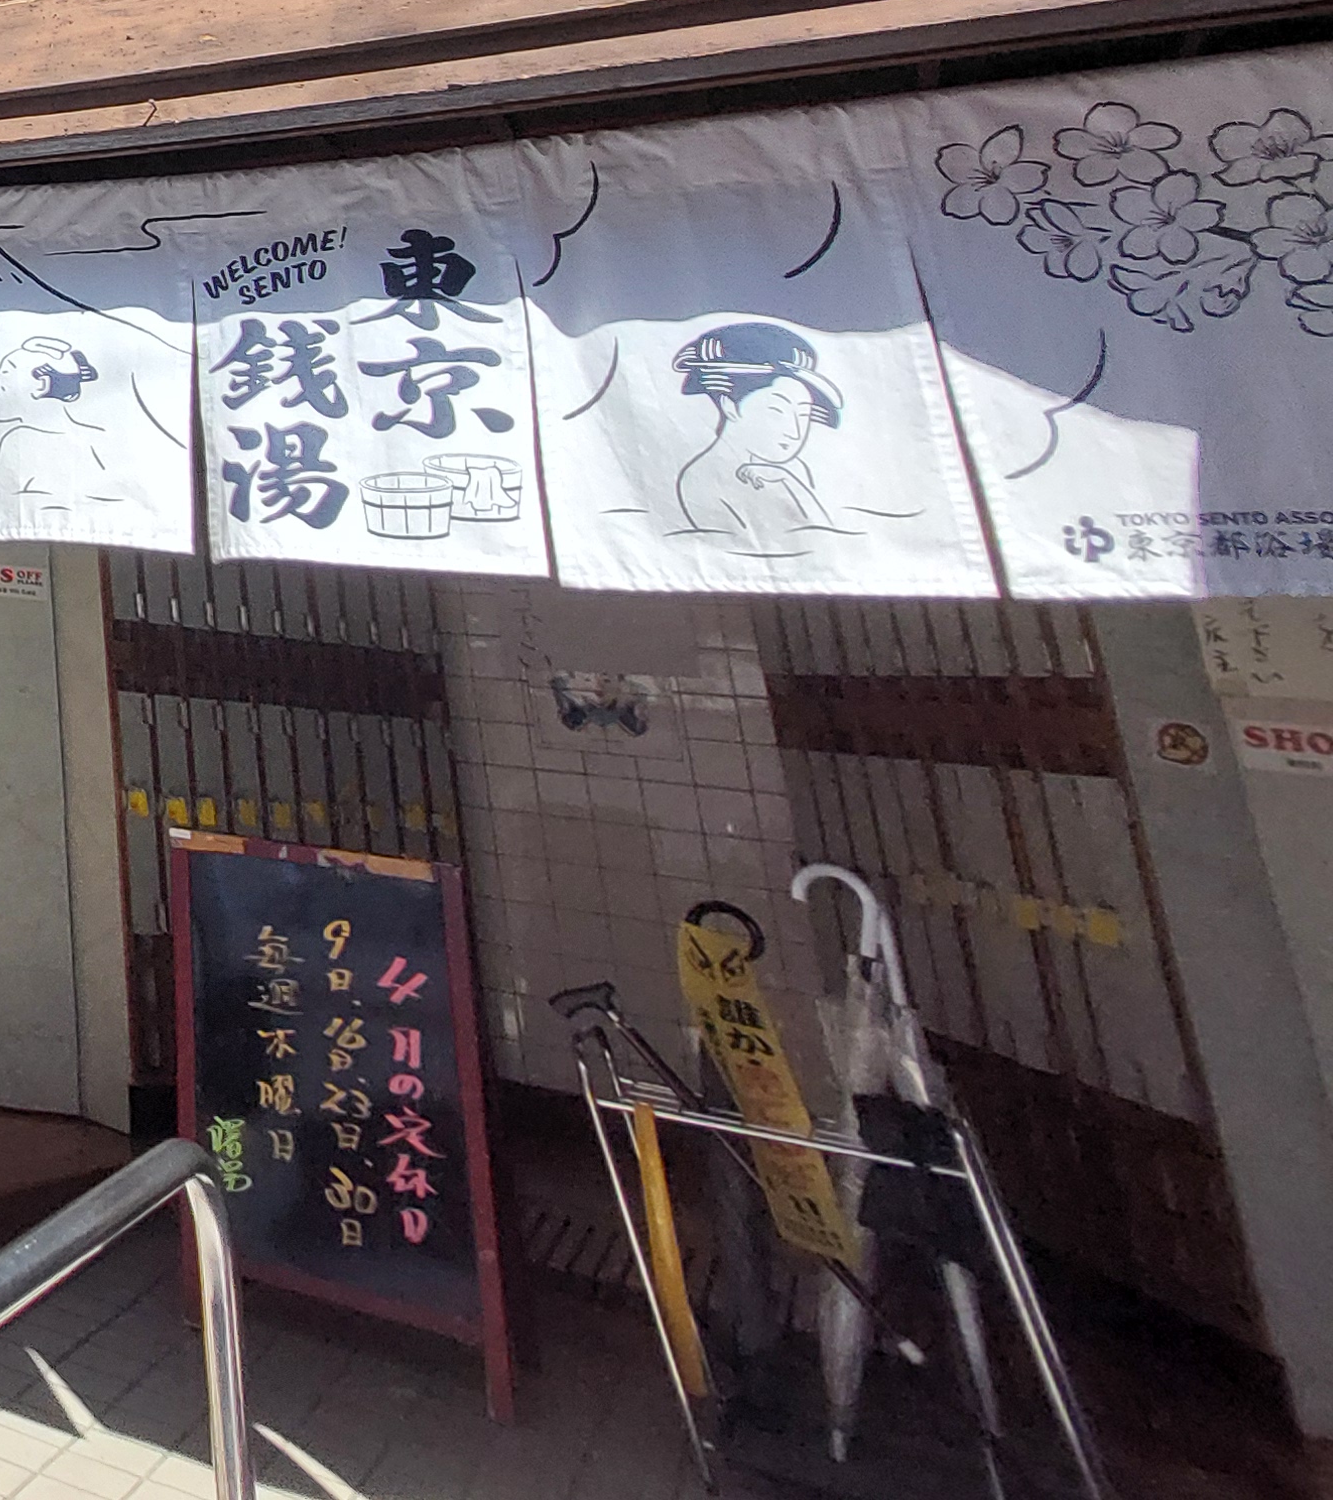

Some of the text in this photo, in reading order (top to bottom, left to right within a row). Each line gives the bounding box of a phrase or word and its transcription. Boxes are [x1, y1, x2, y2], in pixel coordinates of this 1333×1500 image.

[203, 226, 347, 300] WELCOME!
[238, 259, 328, 306] SENTO
[349, 229, 515, 439] 東京
[208, 319, 349, 529] 銭湯
[1114, 510, 1333, 526] TOKYO SENTO ASSO
[16, 570, 42, 581] OFF
